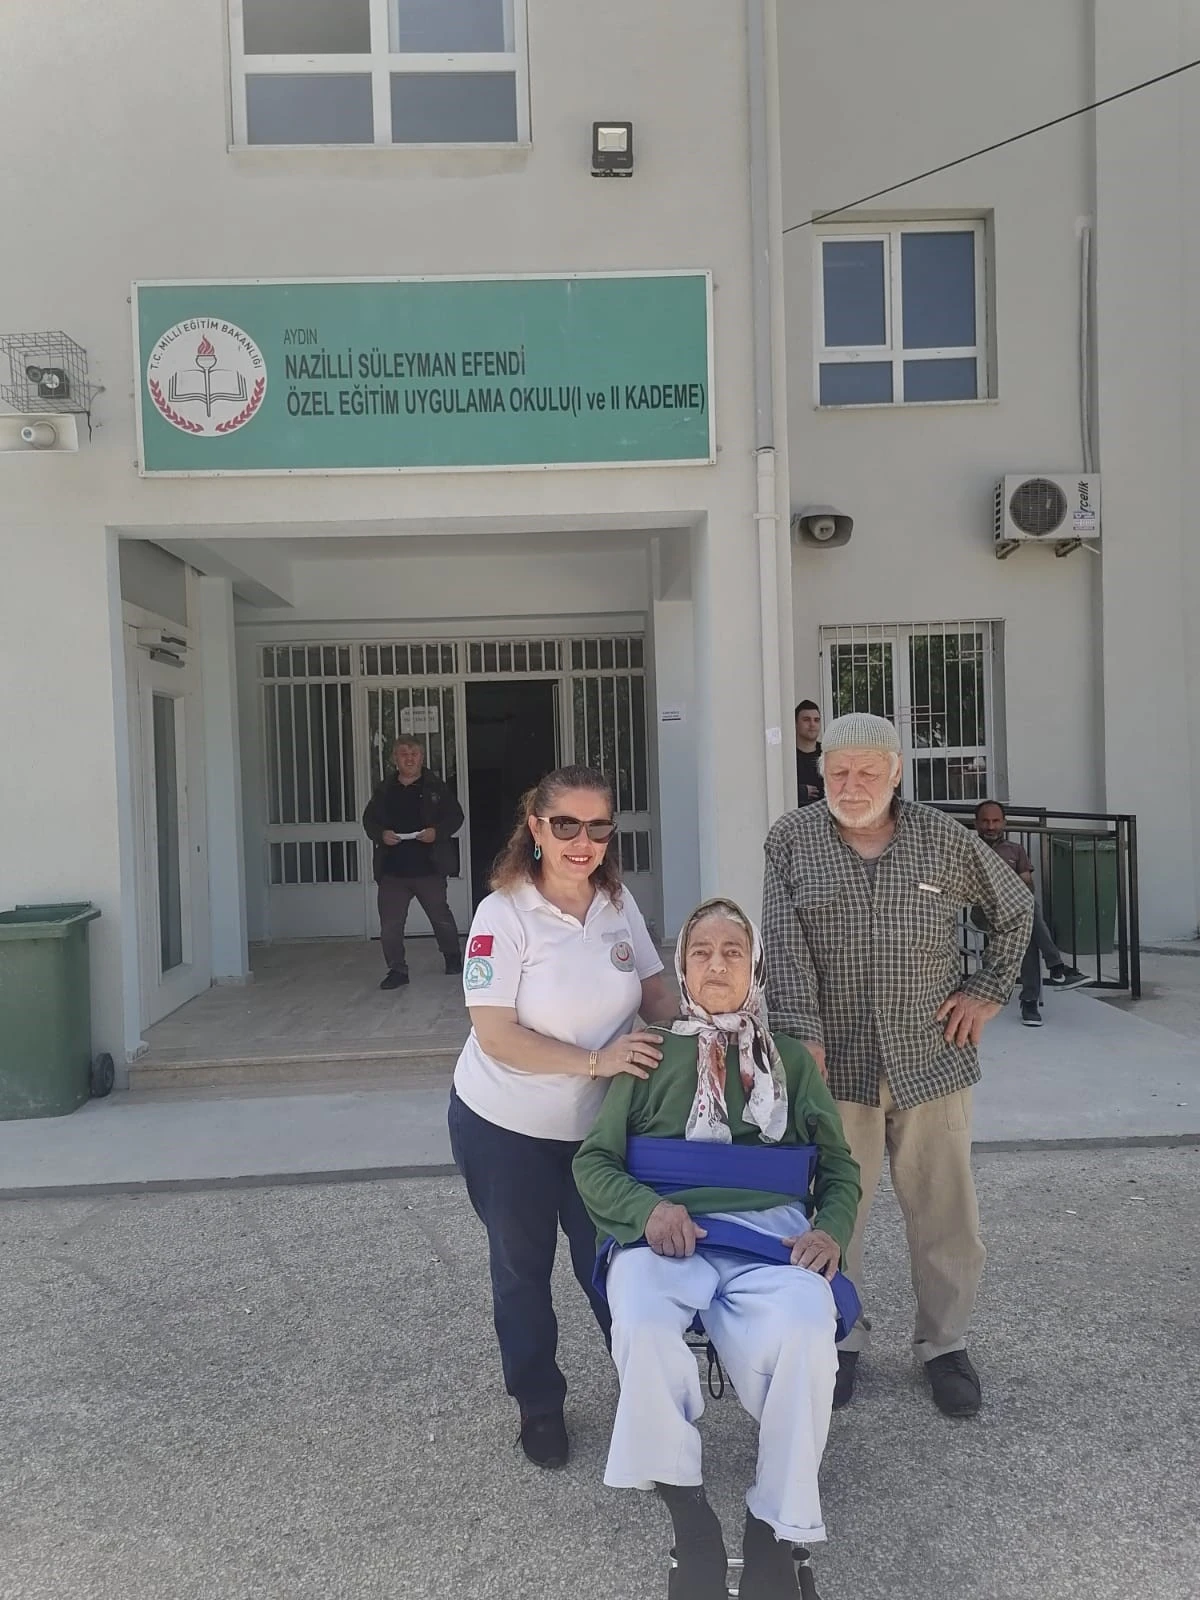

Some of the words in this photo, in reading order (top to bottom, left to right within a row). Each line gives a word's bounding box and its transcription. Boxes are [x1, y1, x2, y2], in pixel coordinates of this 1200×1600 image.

[150, 352, 163, 370] T.C.
[158, 325, 183, 351] MİLLİ
[183, 318, 219, 332] EĞİTİM
[220, 324, 263, 369] BAKANLIĞI
[283, 328, 318, 345] AYDIN
[285, 347, 353, 380] NAZİLLİ
[358, 347, 457, 379] SÜLEYMAN
[462, 344, 526, 377] EFENDİ
[287, 385, 335, 416] ÖZEL
[339, 384, 399, 416] EĞİTİM
[404, 387, 506, 415] UYGULAMA
[586, 391, 606, 410] ve
[625, 383, 705, 415] KADEME)
